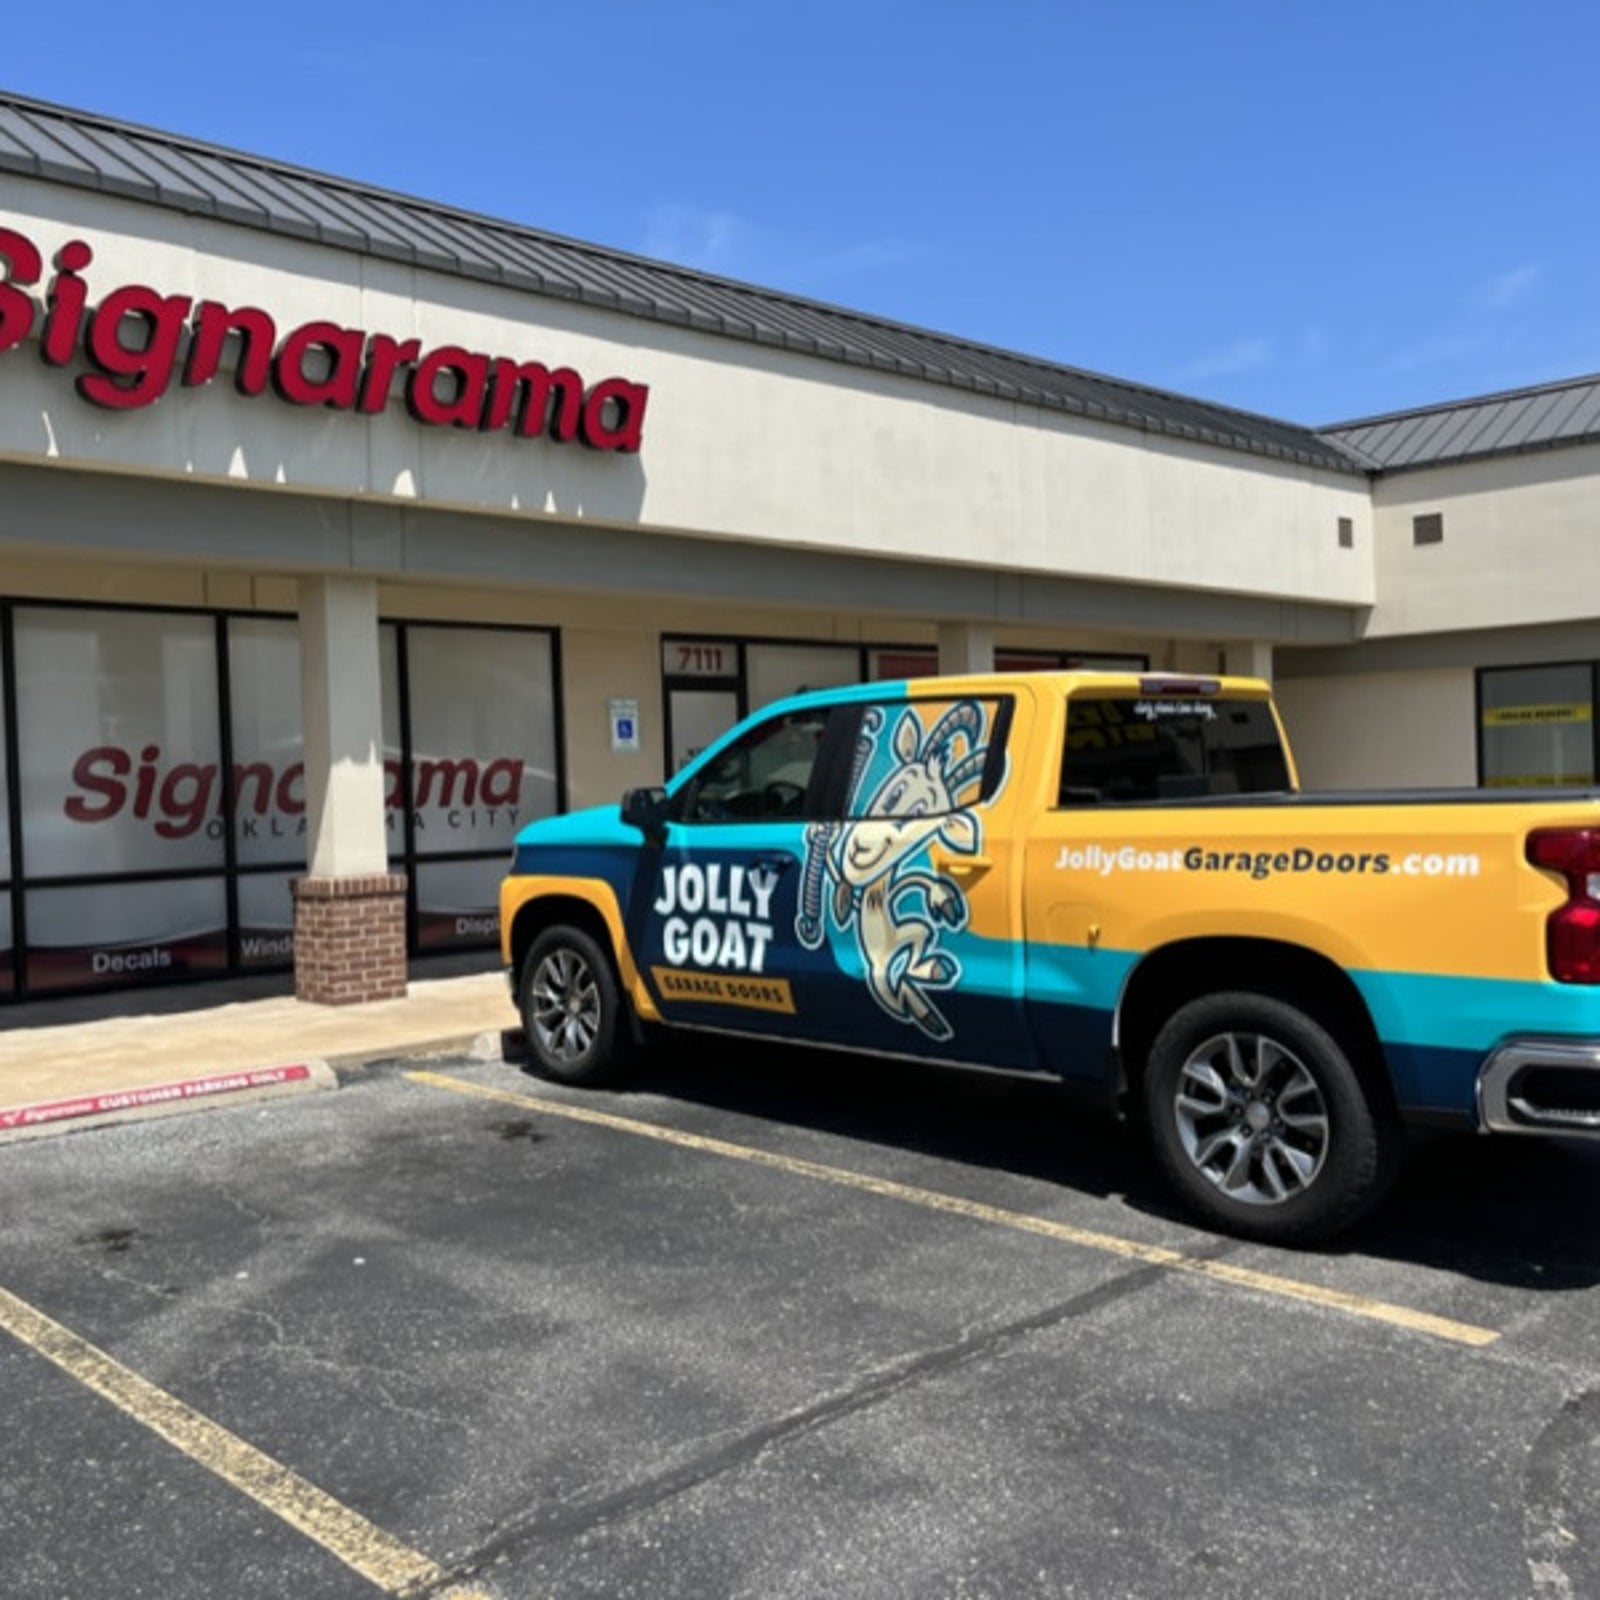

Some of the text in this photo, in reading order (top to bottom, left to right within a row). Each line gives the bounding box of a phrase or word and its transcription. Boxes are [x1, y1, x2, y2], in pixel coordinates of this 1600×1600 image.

[679, 647, 722, 671] 7111
[64, 744, 524, 840] Signaama
[448, 808, 520, 828] CITY
[1055, 845, 1481, 880] JollyGoatGarageDoors.com
[654, 863, 778, 919] JOLLY
[241, 936, 291, 957] Wind
[663, 917, 774, 972] GOAT
[92, 947, 172, 974] Decals
[664, 976, 784, 1003] GARAGE DOORS
[98, 1086, 182, 1110] CUSTOMER
[184, 1075, 249, 1096] PARKING
